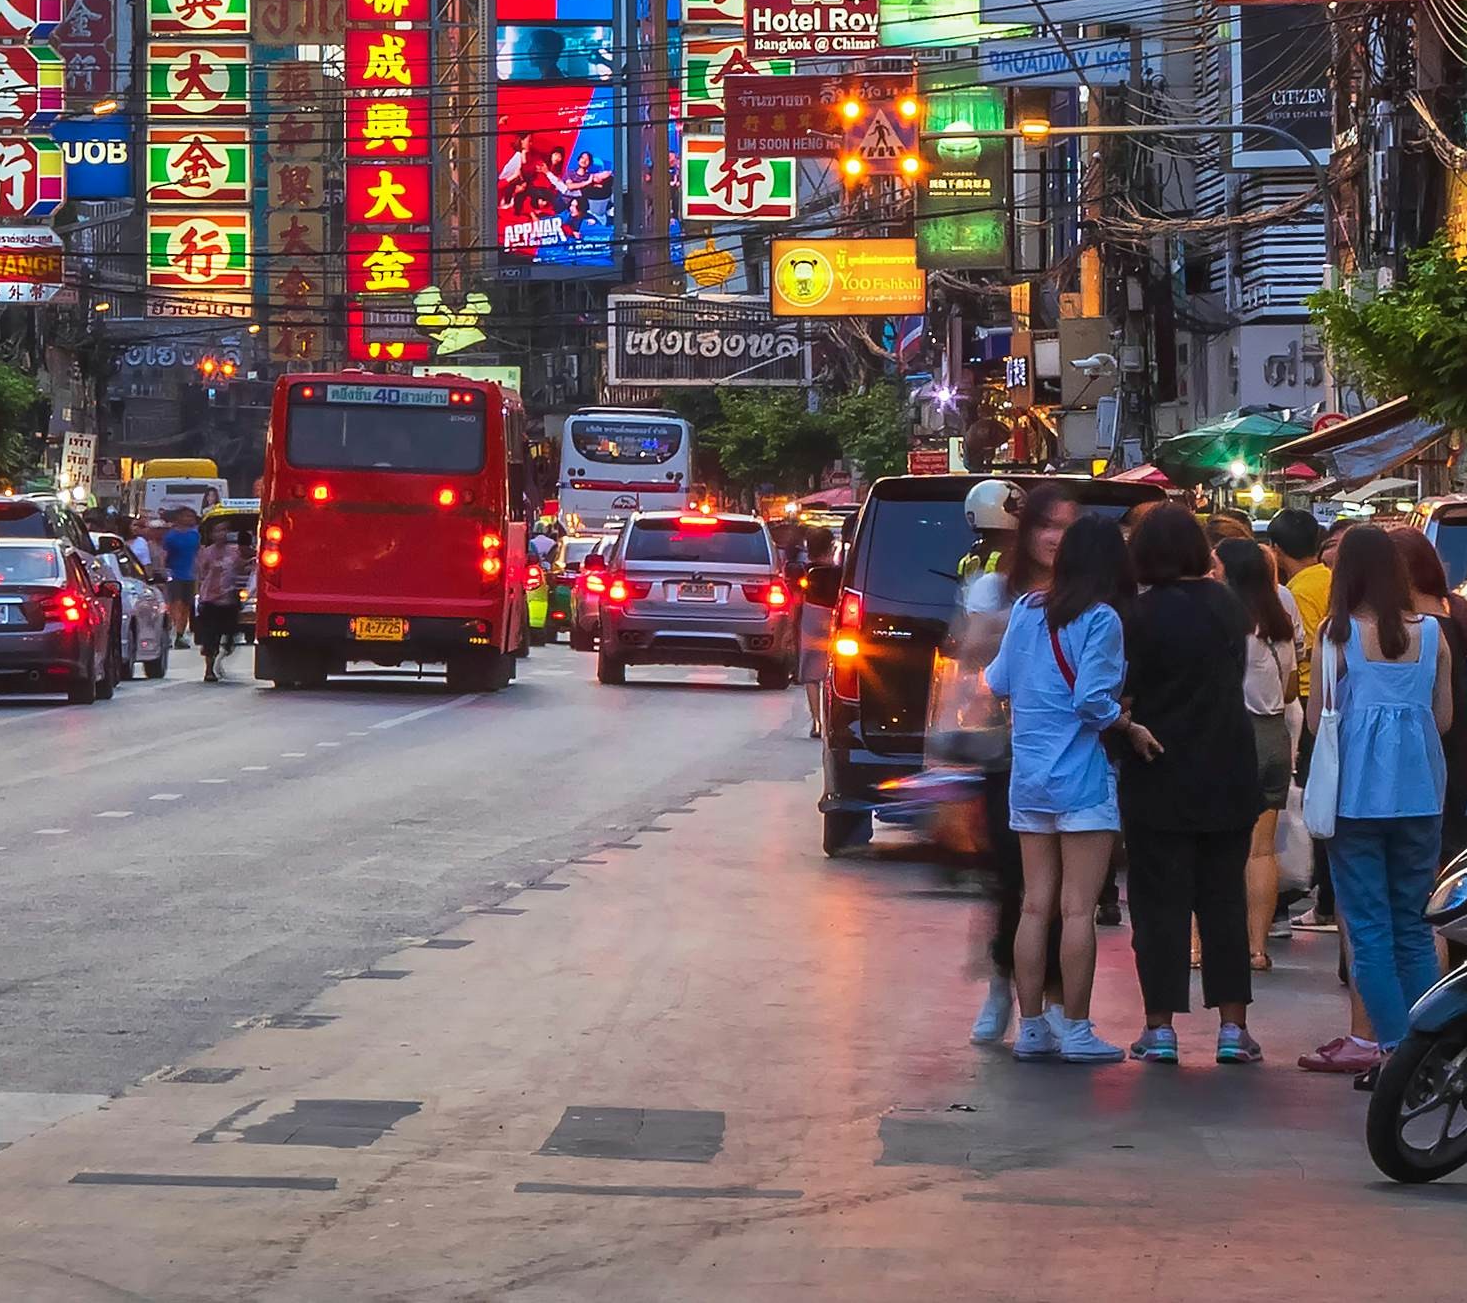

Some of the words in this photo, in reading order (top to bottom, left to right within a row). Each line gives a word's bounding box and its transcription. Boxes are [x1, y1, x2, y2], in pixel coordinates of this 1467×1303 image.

[752, 8, 822, 32] Hotel
[829, 8, 879, 35] Roy
[754, 38, 812, 53] Bangkok
[814, 37, 831, 54] @
[832, 38, 880, 50] Chinat
[1096, 50, 1150, 74] HOTL
[63, 139, 128, 167] UOB
[373, 388, 400, 404] 40
